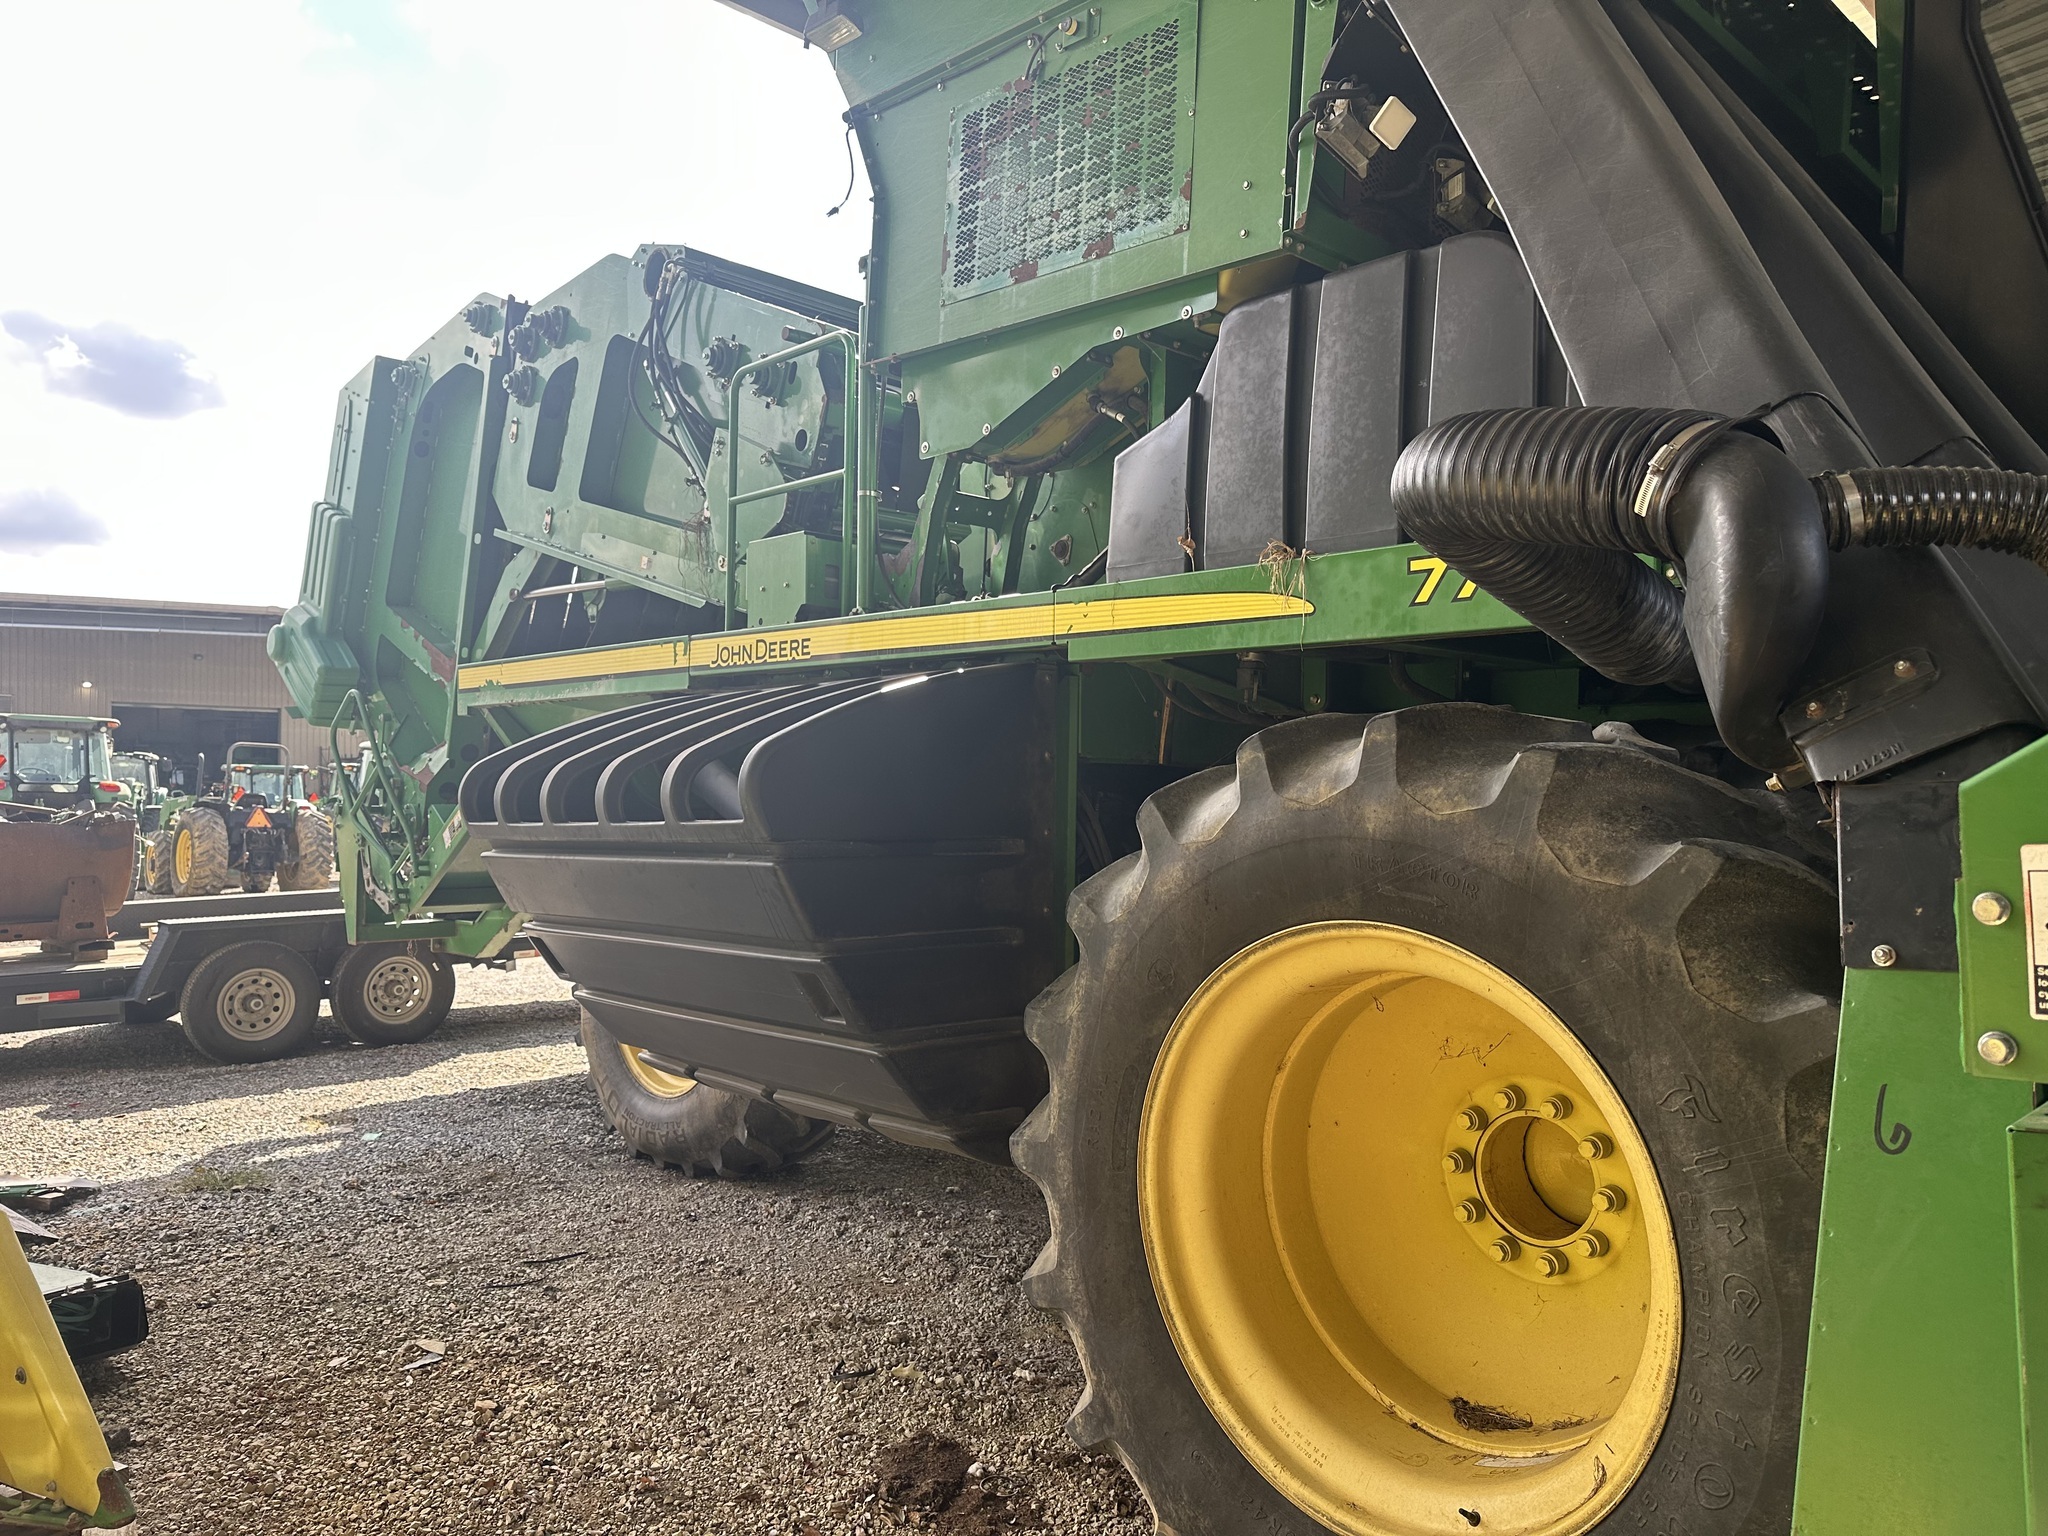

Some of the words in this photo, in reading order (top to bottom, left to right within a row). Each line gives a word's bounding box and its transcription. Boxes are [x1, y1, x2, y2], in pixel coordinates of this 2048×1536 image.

[711, 643, 753, 665] JOHN
[755, 638, 811, 660] DEERE
[1350, 851, 1480, 901] TRACTOR
[621, 1114, 688, 1146] RADIAL
[623, 1106, 662, 1131] TRACTION
[664, 1120, 682, 1130] ALL
[1874, 1083, 1912, 1156] 6
[1677, 1190, 1712, 1367] CHAMPION
